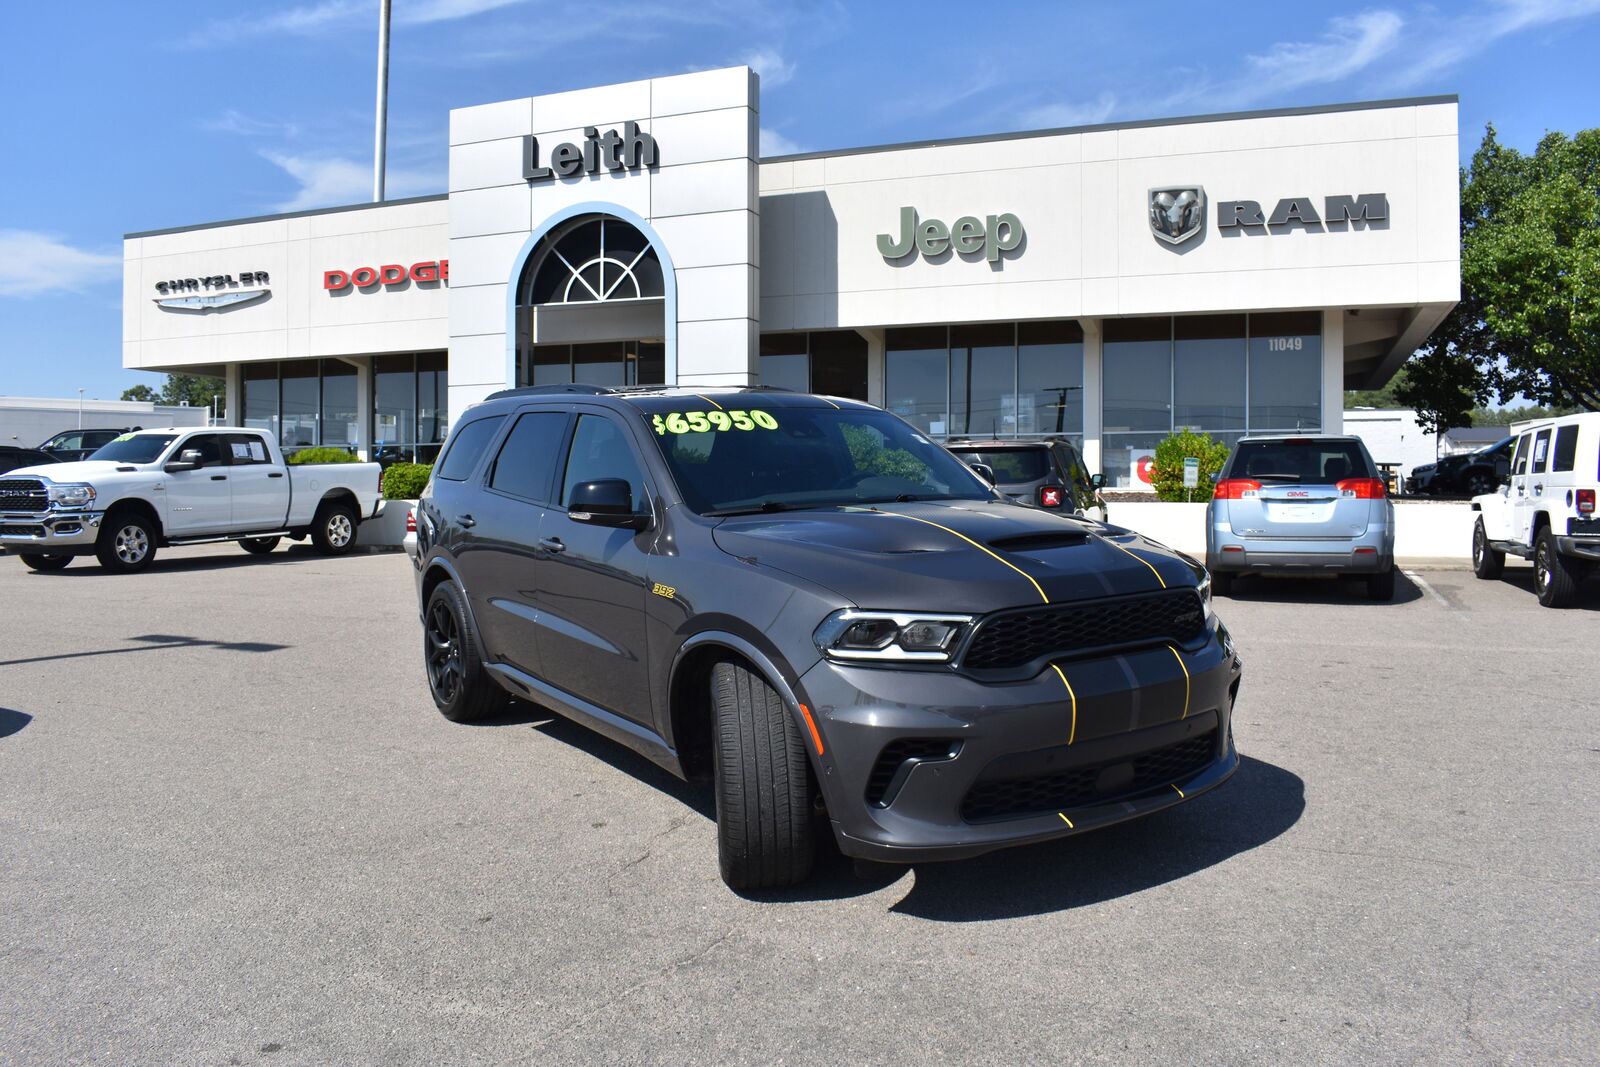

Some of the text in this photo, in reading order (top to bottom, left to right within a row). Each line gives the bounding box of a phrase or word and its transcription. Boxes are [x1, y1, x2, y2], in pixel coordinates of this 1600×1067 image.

[522, 120, 658, 179] Leith
[1217, 193, 1387, 227] RAM
[876, 206, 1023, 262] Jeep
[155, 271, 269, 291] CHRYSLER
[1268, 337, 1302, 351] 11049
[652, 410, 779, 435] $65950
[652, 583, 676, 599] 392
